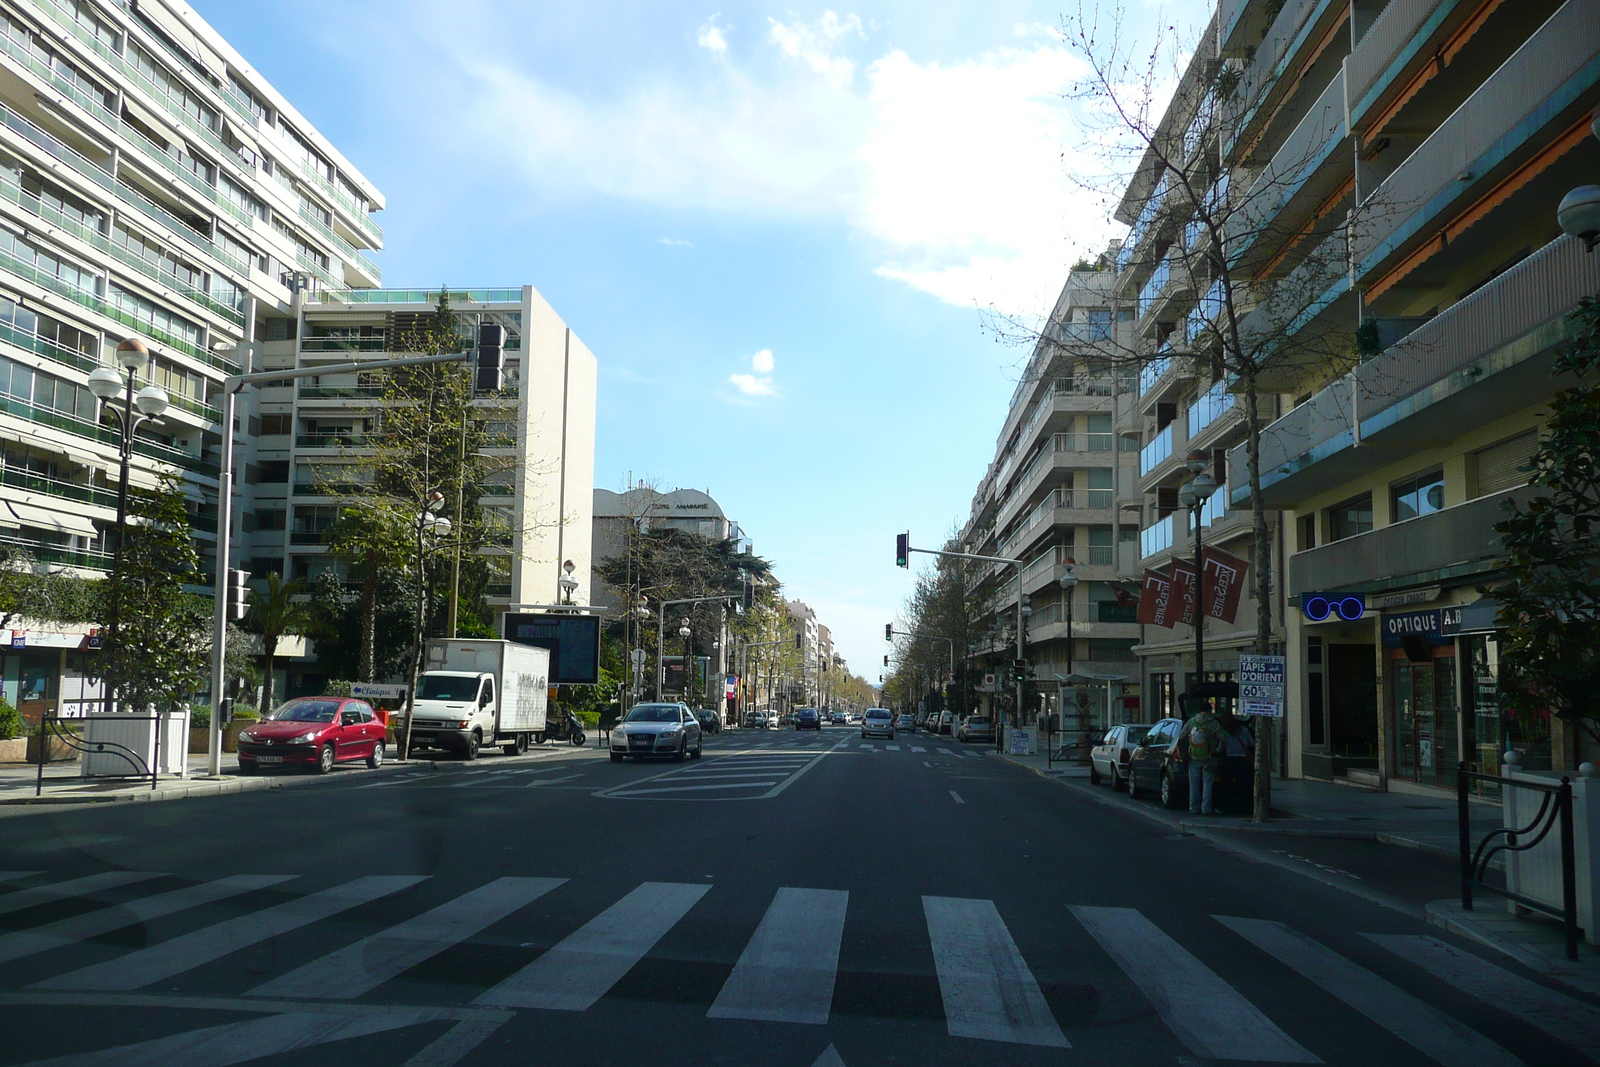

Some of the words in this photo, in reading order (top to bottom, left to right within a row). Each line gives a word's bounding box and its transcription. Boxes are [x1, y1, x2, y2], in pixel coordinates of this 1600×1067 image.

[1388, 614, 1437, 634] OPTIQUE
[1241, 662, 1266, 672] TAPIS
[1241, 672, 1282, 682] D'ORIENT
[361, 686, 391, 697] Clinique
[1243, 685, 1266, 697] 60%
